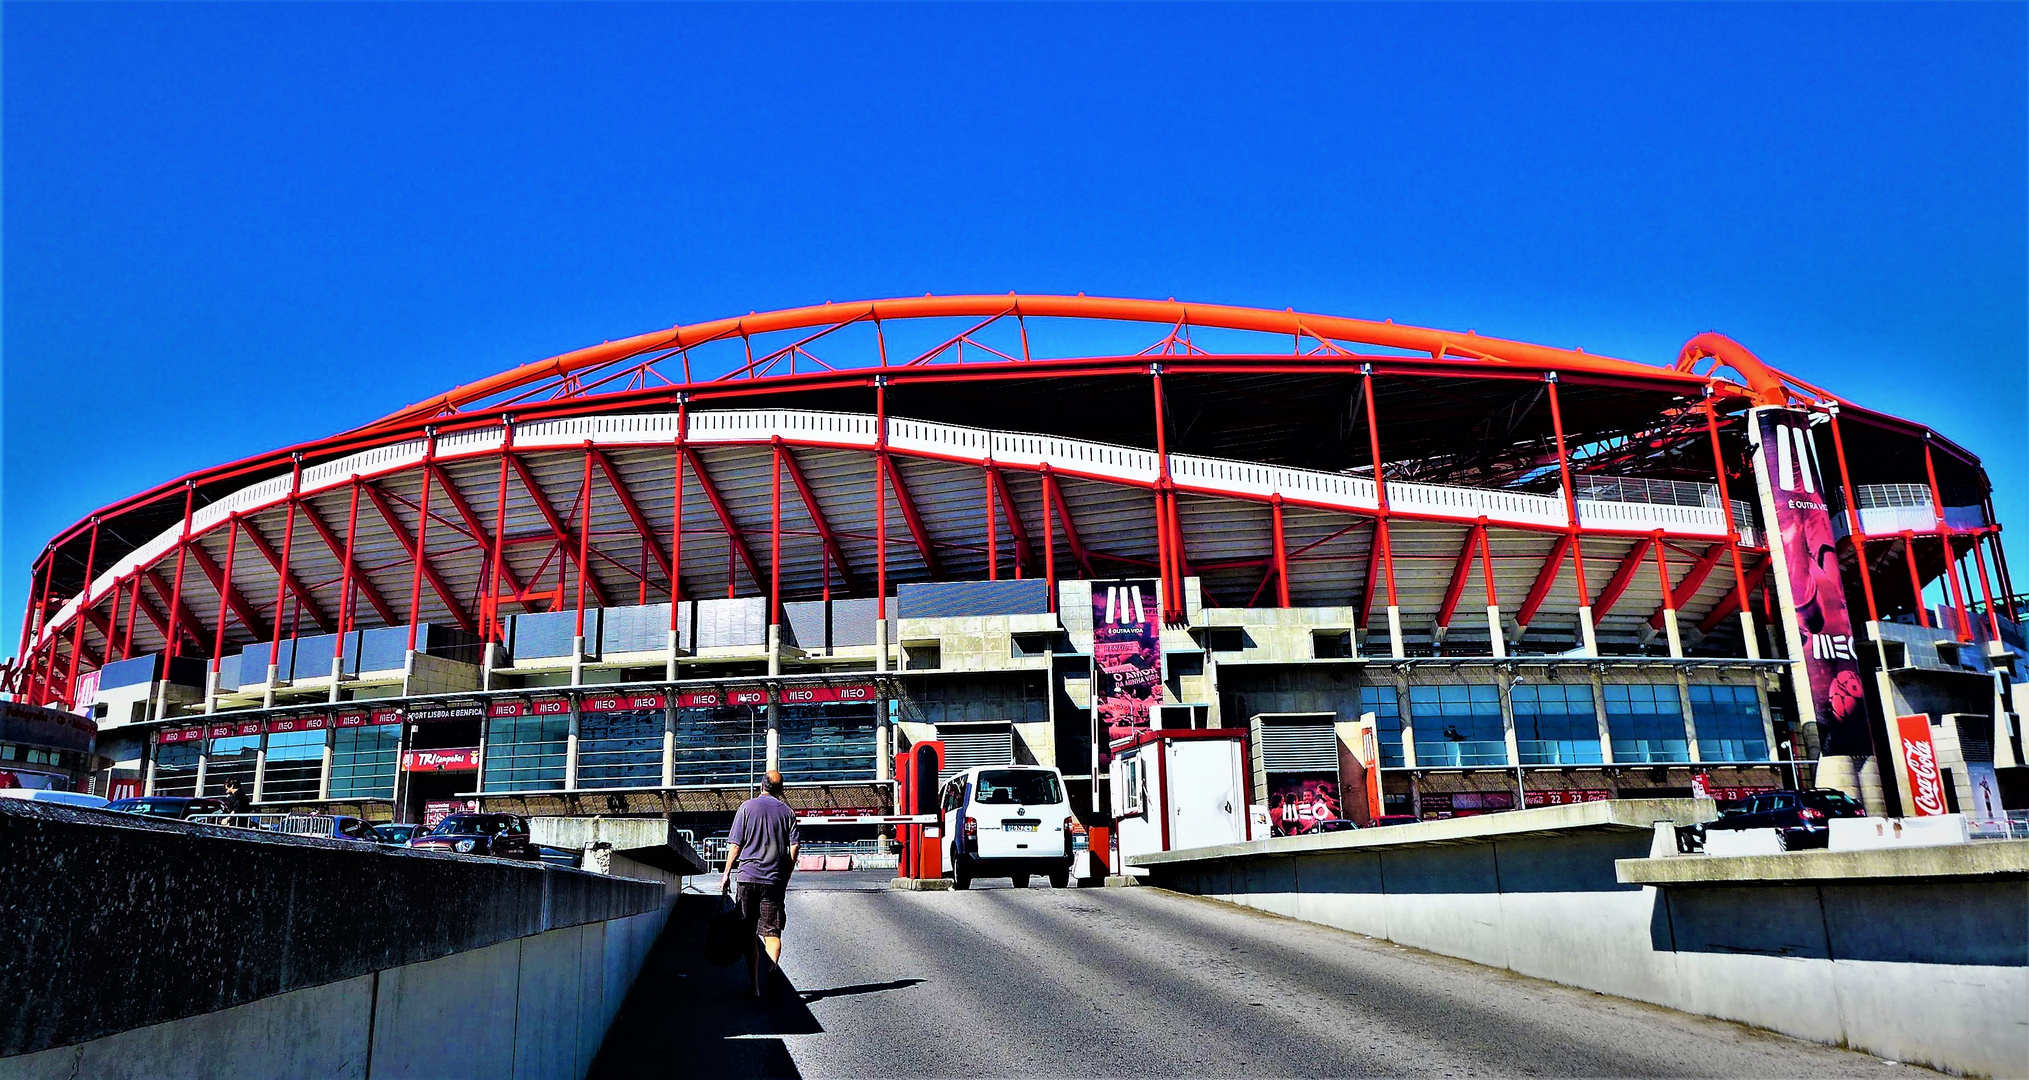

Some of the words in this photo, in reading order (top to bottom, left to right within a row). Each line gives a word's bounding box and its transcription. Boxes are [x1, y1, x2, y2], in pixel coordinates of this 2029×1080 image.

[1796, 500, 1818, 510] OUTRA
[1113, 673, 1123, 681] O
[1125, 678, 1145, 686] MINHA
[1145, 674, 1160, 682] VIDA
[789, 691, 812, 700] MEO
[841, 688, 865, 698] MEO
[634, 697, 655, 707] MEO
[693, 695, 716, 704] MEO
[539, 702, 560, 712] MEO
[594, 700, 616, 709] MEO
[407, 712, 427, 720] SPORT
[428, 710, 449, 718] LISBOA
[456, 708, 482, 716] BENFICA
[496, 705, 516, 714] MEO
[343, 716, 360, 725] MEO
[380, 713, 397, 722] MEO
[278, 722, 293, 730] MEO
[306, 719, 322, 728] MEO
[243, 725, 257, 733] MEO
[1550, 795, 1561, 804] 22
[1571, 795, 1582, 803] 22
[1728, 791, 1737, 800] 23
[1282, 802, 1329, 821] MEO
